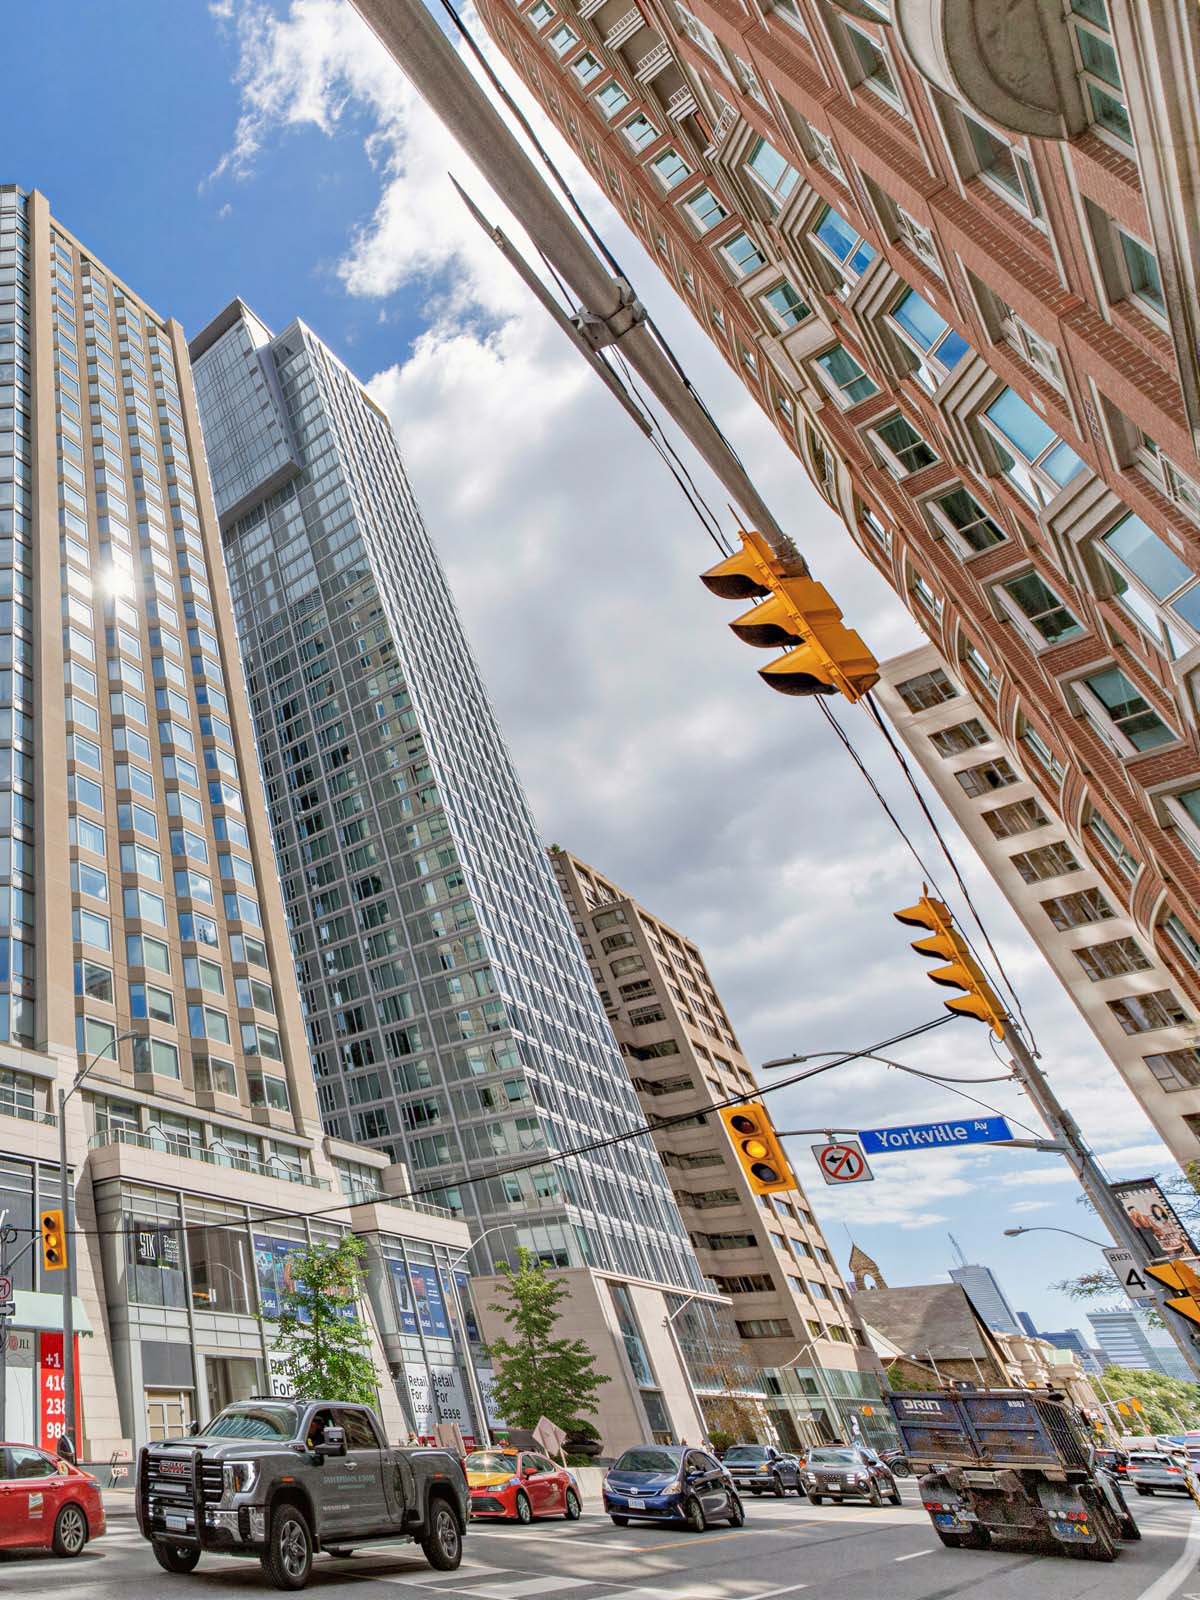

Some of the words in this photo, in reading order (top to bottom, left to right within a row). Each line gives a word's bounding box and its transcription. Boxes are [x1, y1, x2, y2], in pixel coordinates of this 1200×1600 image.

[875, 1123, 968, 1147] Yorkville
[974, 1120, 987, 1131] Av
[140, 1232, 156, 1257] STK
[1126, 1268, 1146, 1290] 4
[18, 1338, 31, 1349] JLL
[46, 1352, 60, 1368] +1
[273, 1379, 293, 1395] For
[408, 1375, 428, 1387] Retail
[432, 1373, 455, 1387] Retail
[411, 1388, 422, 1400] For
[413, 1402, 432, 1414] Lease
[440, 1406, 461, 1419] Lease
[46, 1421, 66, 1439] 98
